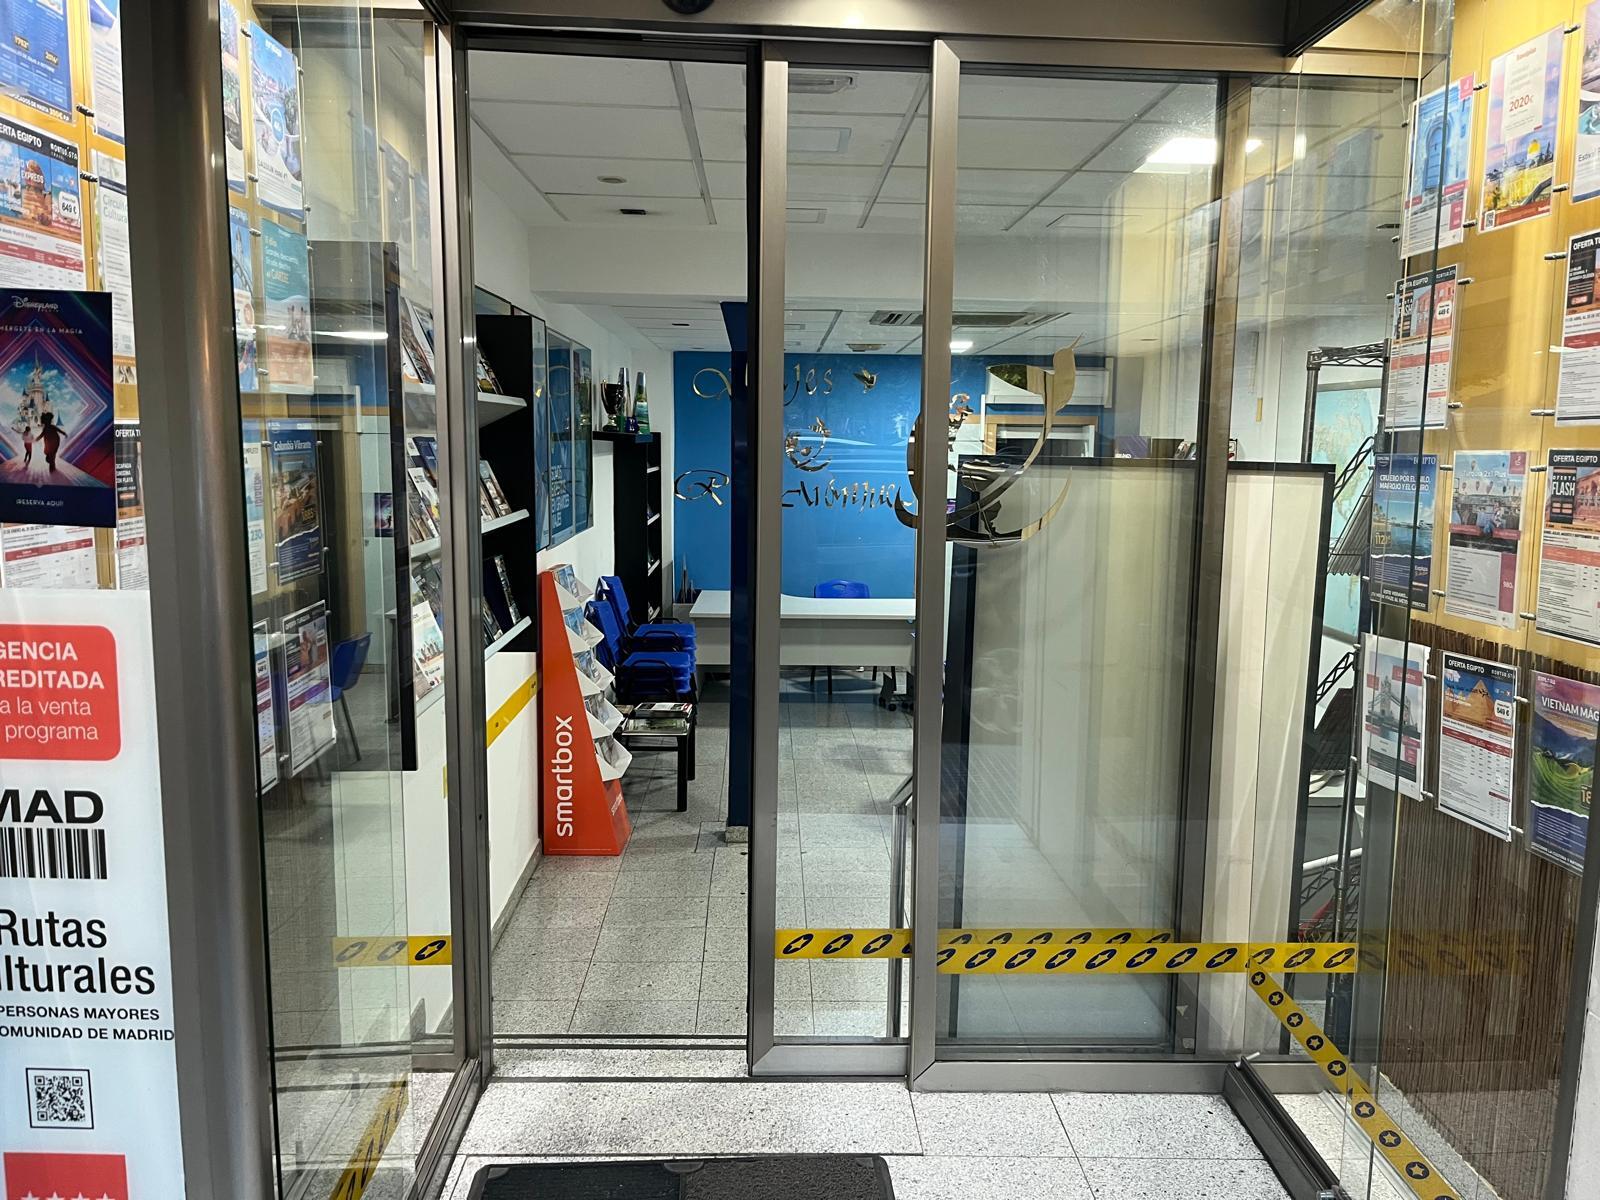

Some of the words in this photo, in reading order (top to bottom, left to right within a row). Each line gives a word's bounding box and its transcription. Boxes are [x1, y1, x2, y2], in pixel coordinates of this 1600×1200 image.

[17, 129, 42, 148] EGIPTO
[1573, 238, 1594, 250] OFERTA
[116, 429, 135, 438] OFERTA
[1414, 456, 1436, 464] EIPTO
[1553, 455, 1575, 463] OFERTA
[1576, 455, 1598, 464] EGIPTO
[1551, 482, 1575, 496] FLASH
[0, 640, 78, 661] GENCIA
[1448, 659, 1466, 670] OFERTA
[1467, 663, 1484, 674] EGIPTO
[0, 668, 105, 690] REDITADA
[18, 697, 36, 715] la
[39, 699, 91, 716] venta
[1541, 696, 1579, 716] VIETNAM
[6, 723, 98, 744] programa
[551, 714, 573, 837] smartbox
[0, 909, 107, 948] Rutas
[0, 955, 156, 994] lturales
[0, 1006, 79, 1018] PERSONAS
[84, 1008, 160, 1020] MAYORES
[0, 1027, 82, 1040] OMUNIDAD
[88, 1028, 108, 1040] DE
[113, 1029, 174, 1041] MADRID
